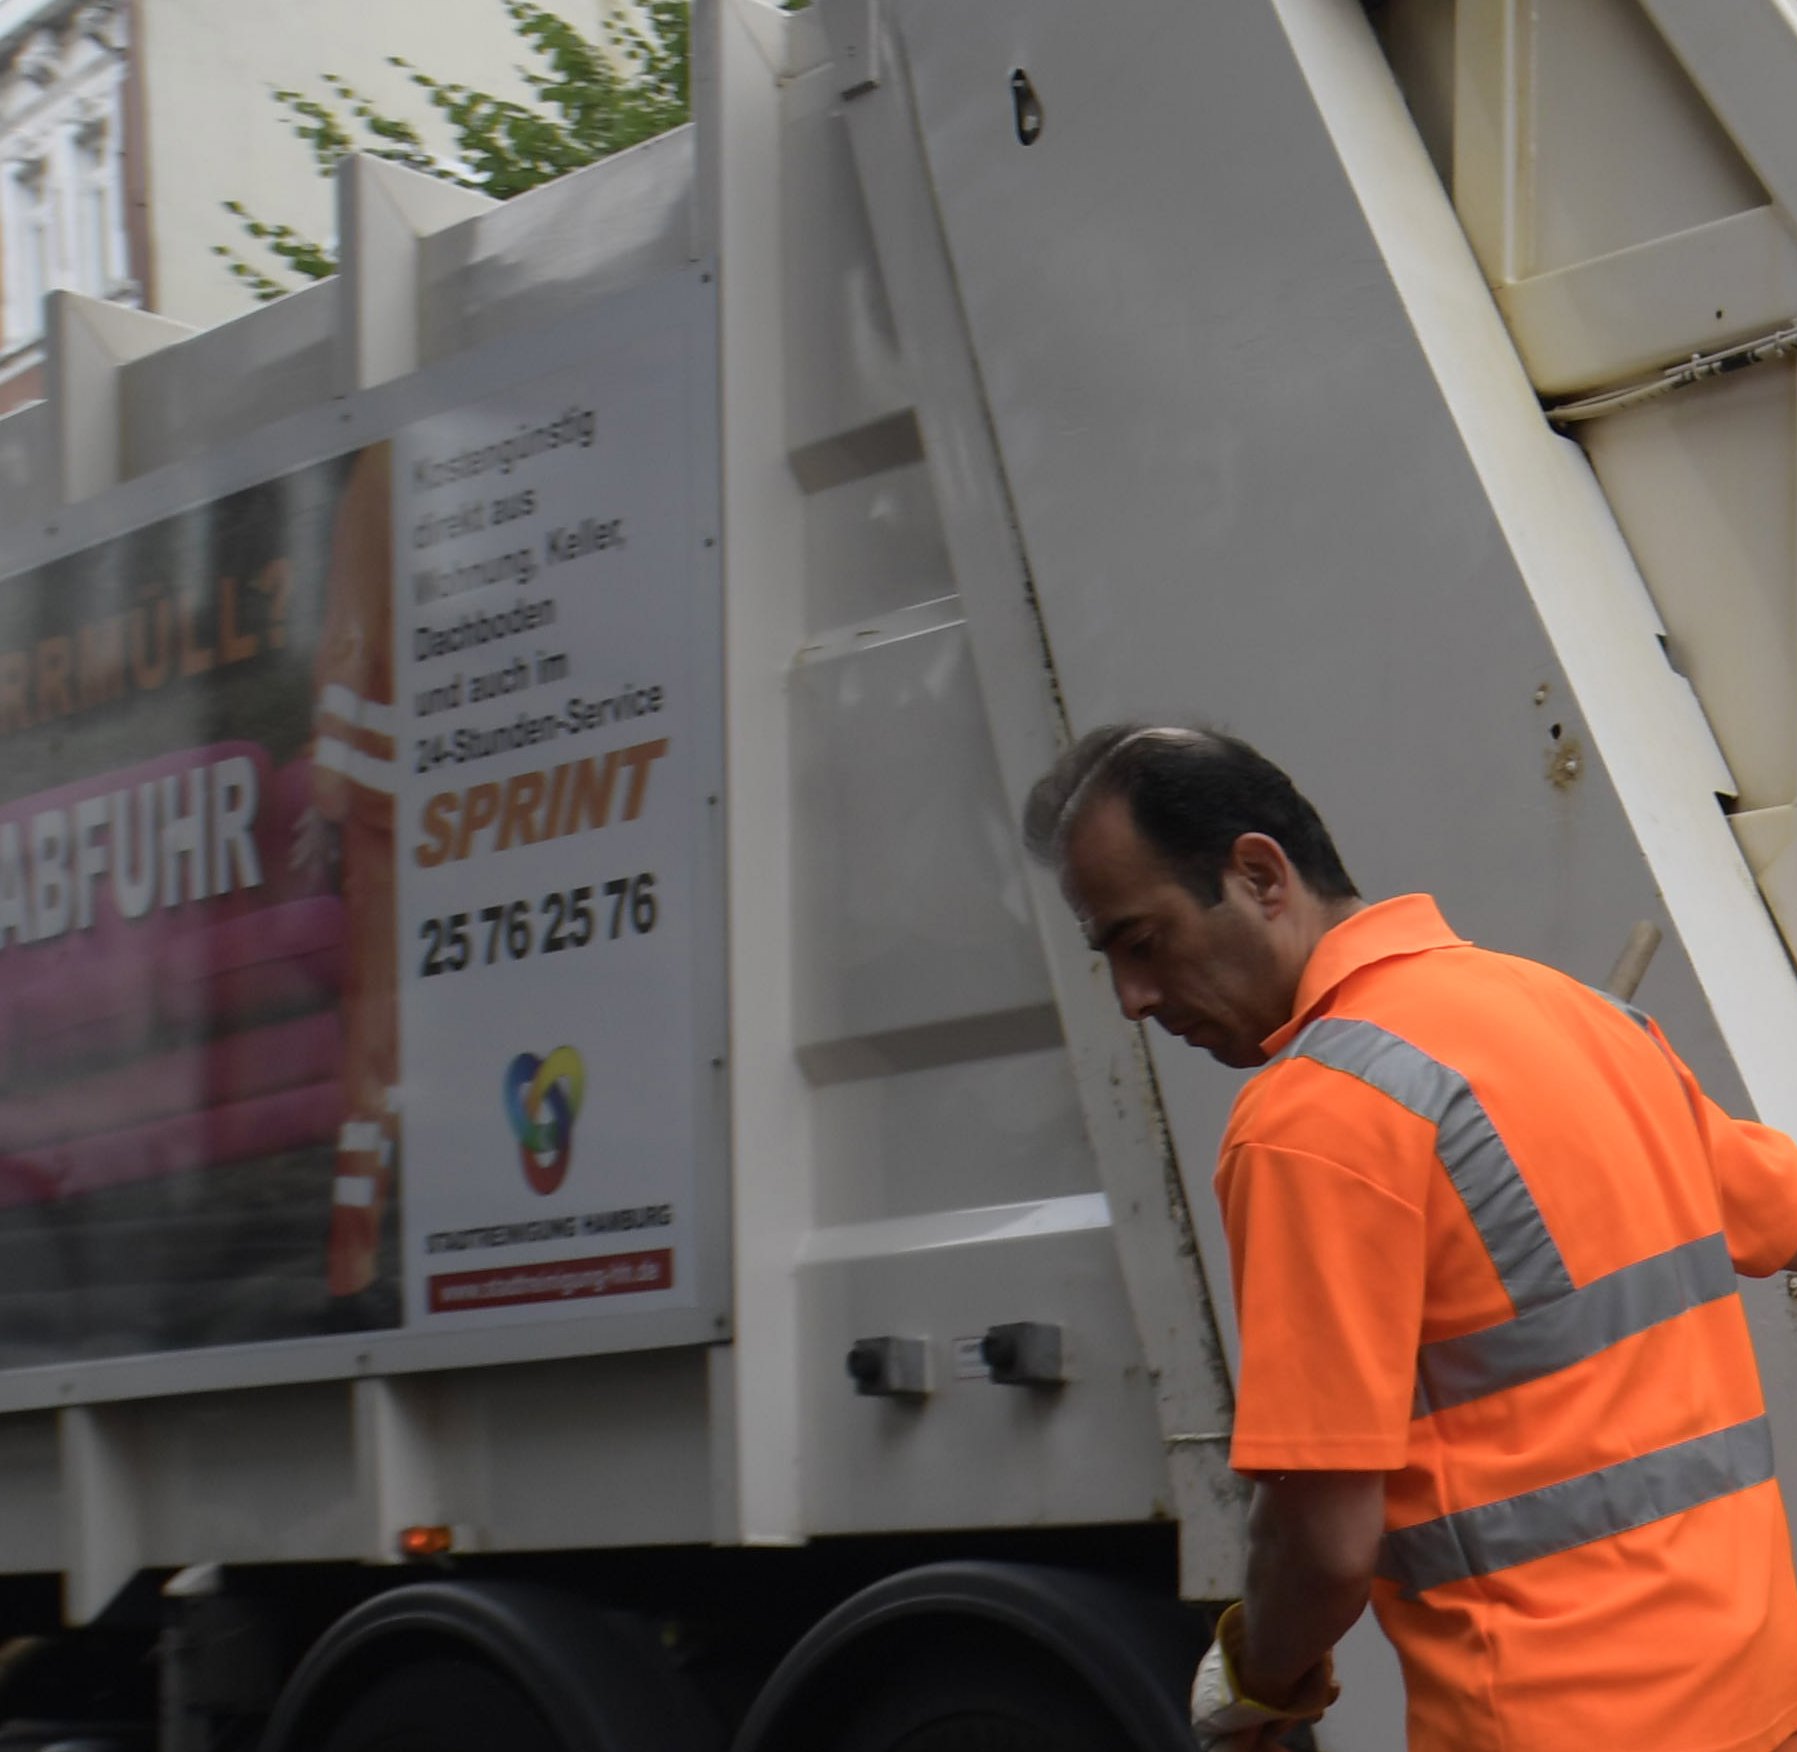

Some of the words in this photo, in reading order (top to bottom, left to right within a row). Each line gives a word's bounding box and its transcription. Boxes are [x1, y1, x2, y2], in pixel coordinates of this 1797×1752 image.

[414, 499, 485, 549] direkt
[492, 489, 537, 525] aus
[546, 516, 628, 565] Keller,
[414, 598, 556, 662] Dachboden
[414, 673, 462, 717] und
[468, 655, 530, 702] auch
[537, 649, 570, 686] im
[414, 683, 663, 775] 24-Stunden-Service
[414, 736, 670, 869] SPRINT
[0, 754, 265, 951] ABFUHR
[419, 912, 471, 977] 25
[479, 899, 531, 964] 76
[540, 885, 594, 954] 25
[603, 871, 658, 940] 76
[581, 1203, 673, 1237] HAMBURG
